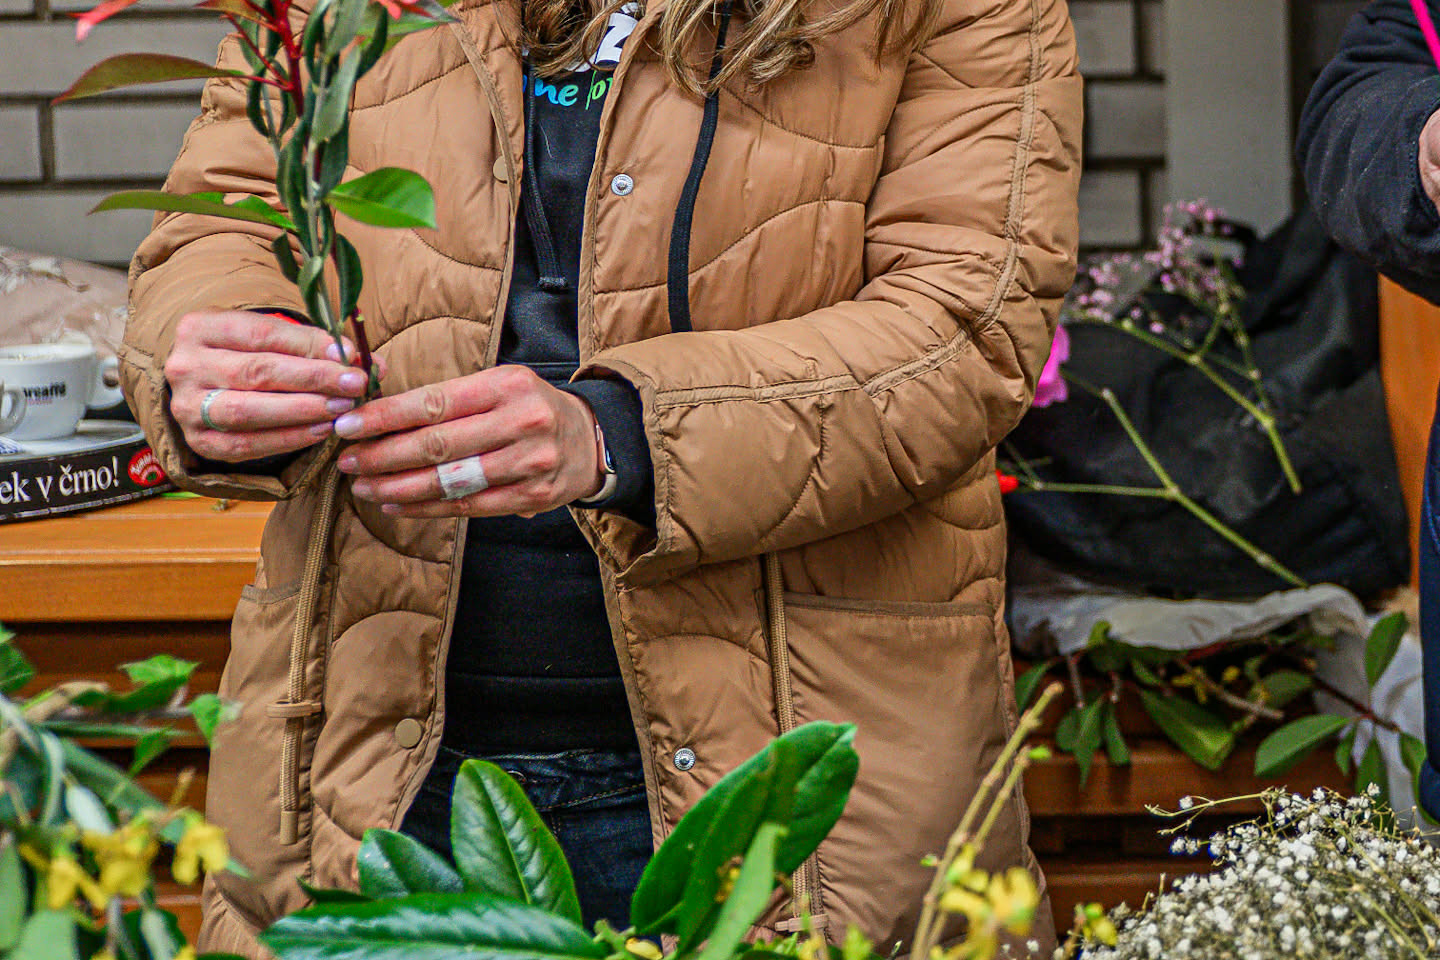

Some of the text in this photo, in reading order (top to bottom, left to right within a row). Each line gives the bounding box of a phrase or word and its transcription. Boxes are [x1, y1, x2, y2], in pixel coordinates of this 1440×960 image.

[0, 471, 31, 504] ek
[35, 475, 54, 502] v
[59, 456, 119, 496] črno!
